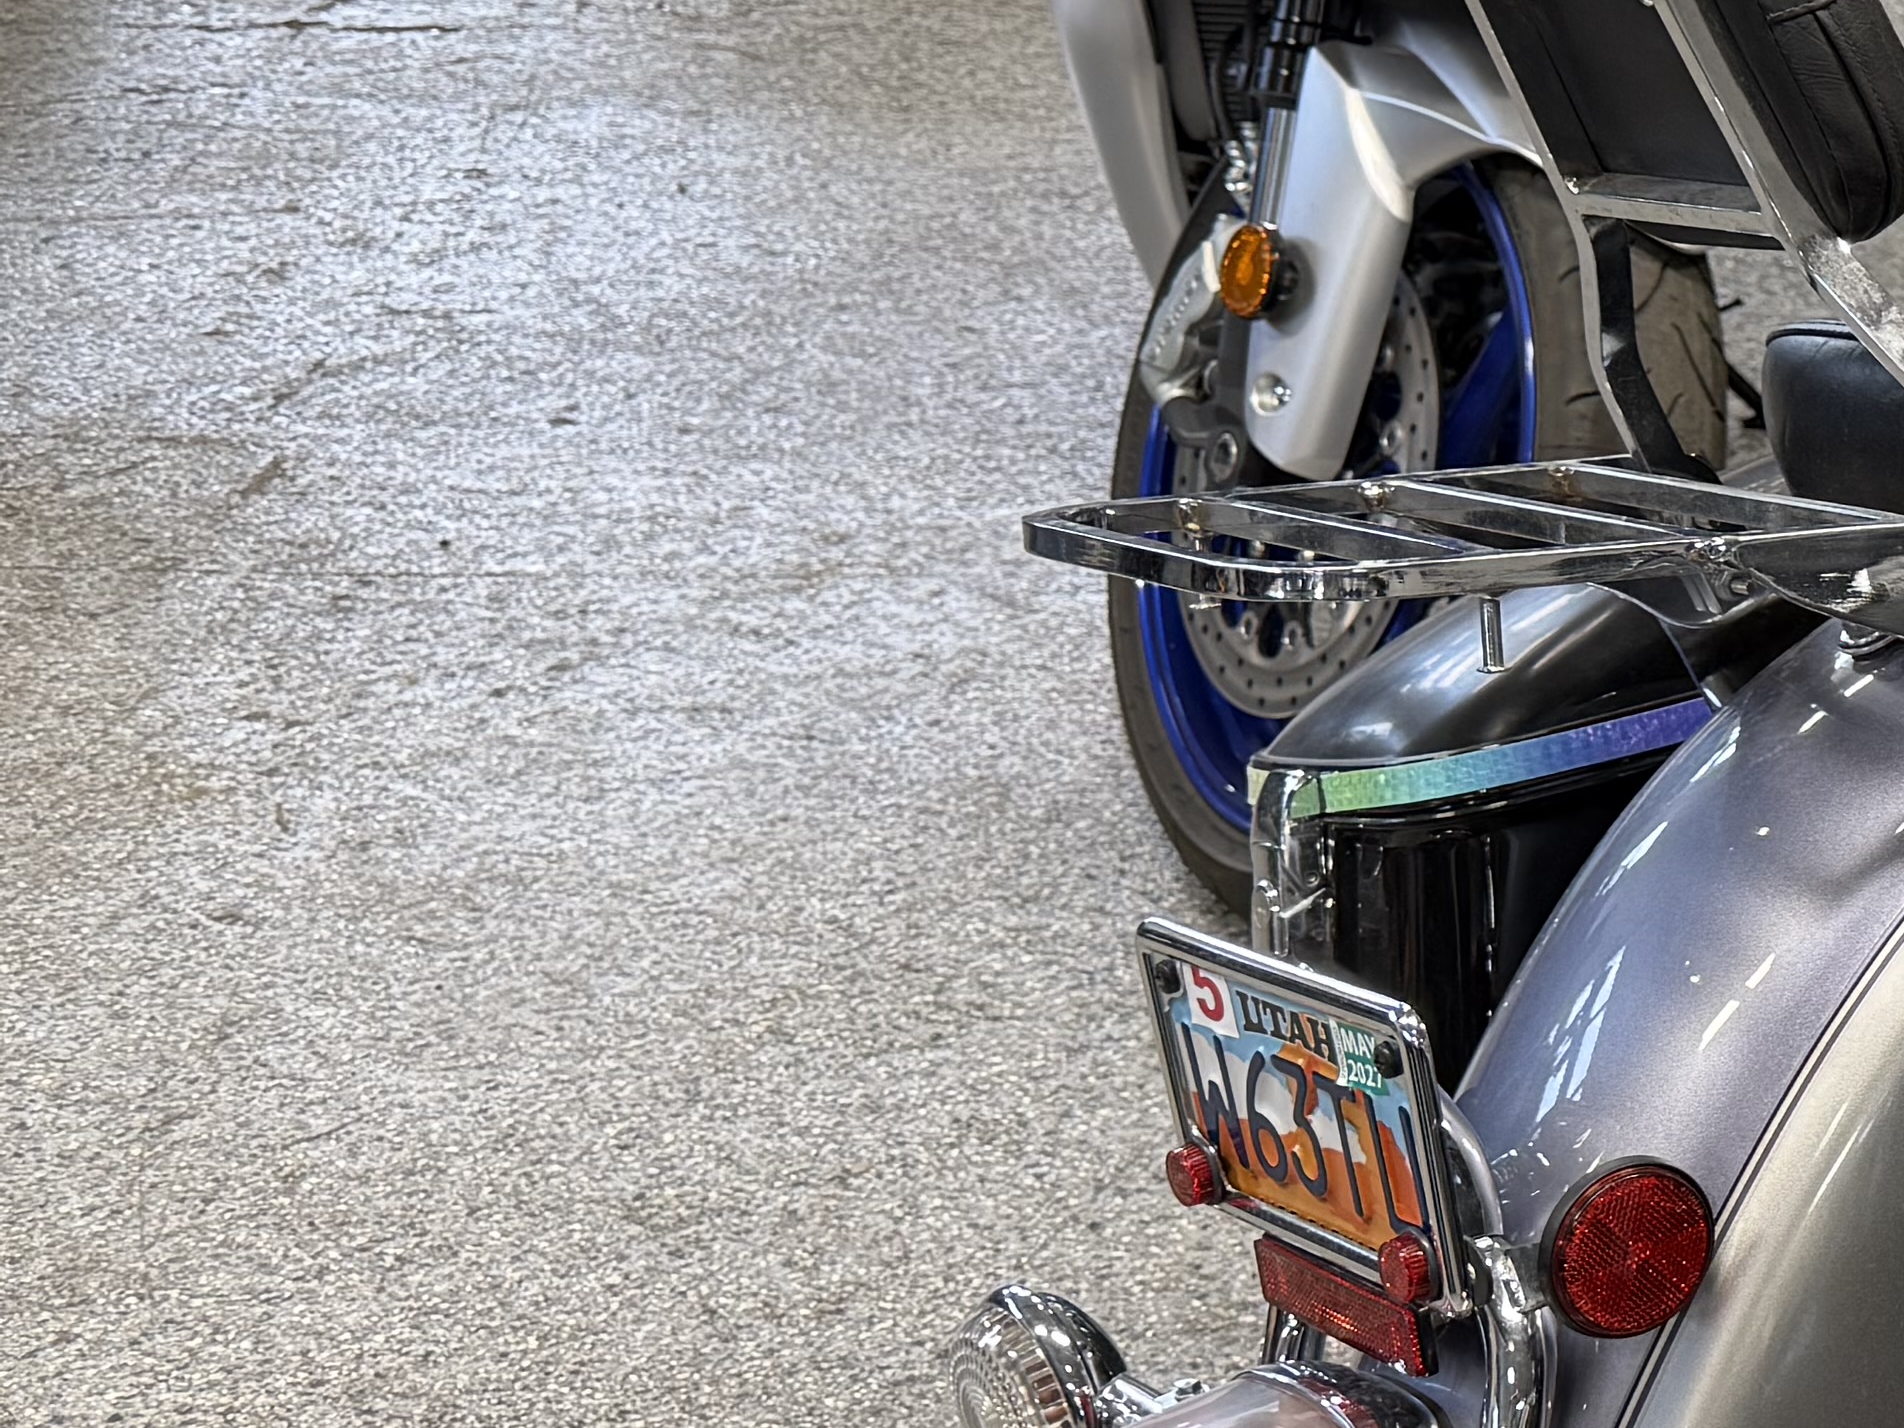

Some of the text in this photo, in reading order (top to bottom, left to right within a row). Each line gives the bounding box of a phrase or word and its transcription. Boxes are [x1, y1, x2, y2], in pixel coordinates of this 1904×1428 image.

[1190, 965, 1225, 1022] 5
[1235, 989, 1338, 1065] UTAH
[1340, 1027, 1375, 1059] MAY
